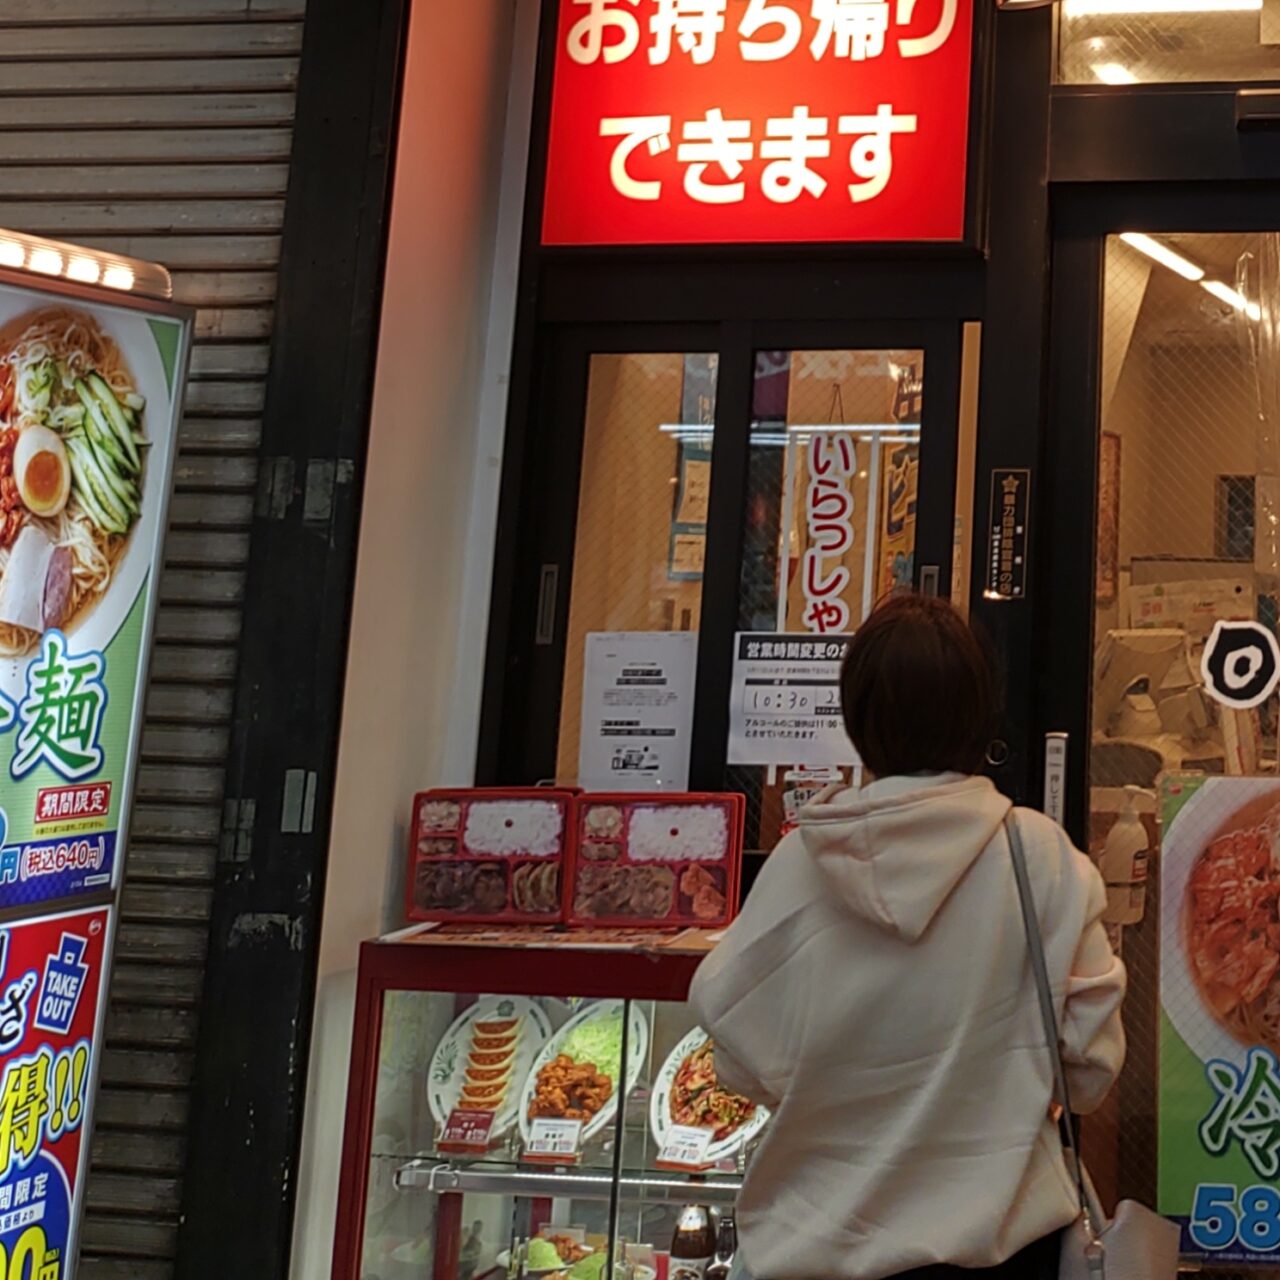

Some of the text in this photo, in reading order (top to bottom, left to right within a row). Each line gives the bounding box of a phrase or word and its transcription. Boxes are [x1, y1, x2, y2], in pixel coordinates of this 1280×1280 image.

[598, 103, 917, 205] できます
[0, 631, 104, 777] 麺
[41, 789, 105, 818] 期間限定
[21, 835, 105, 882] (税込640円)
[46, 970, 79, 998] TAKE
[42, 996, 72, 1022] OUT
